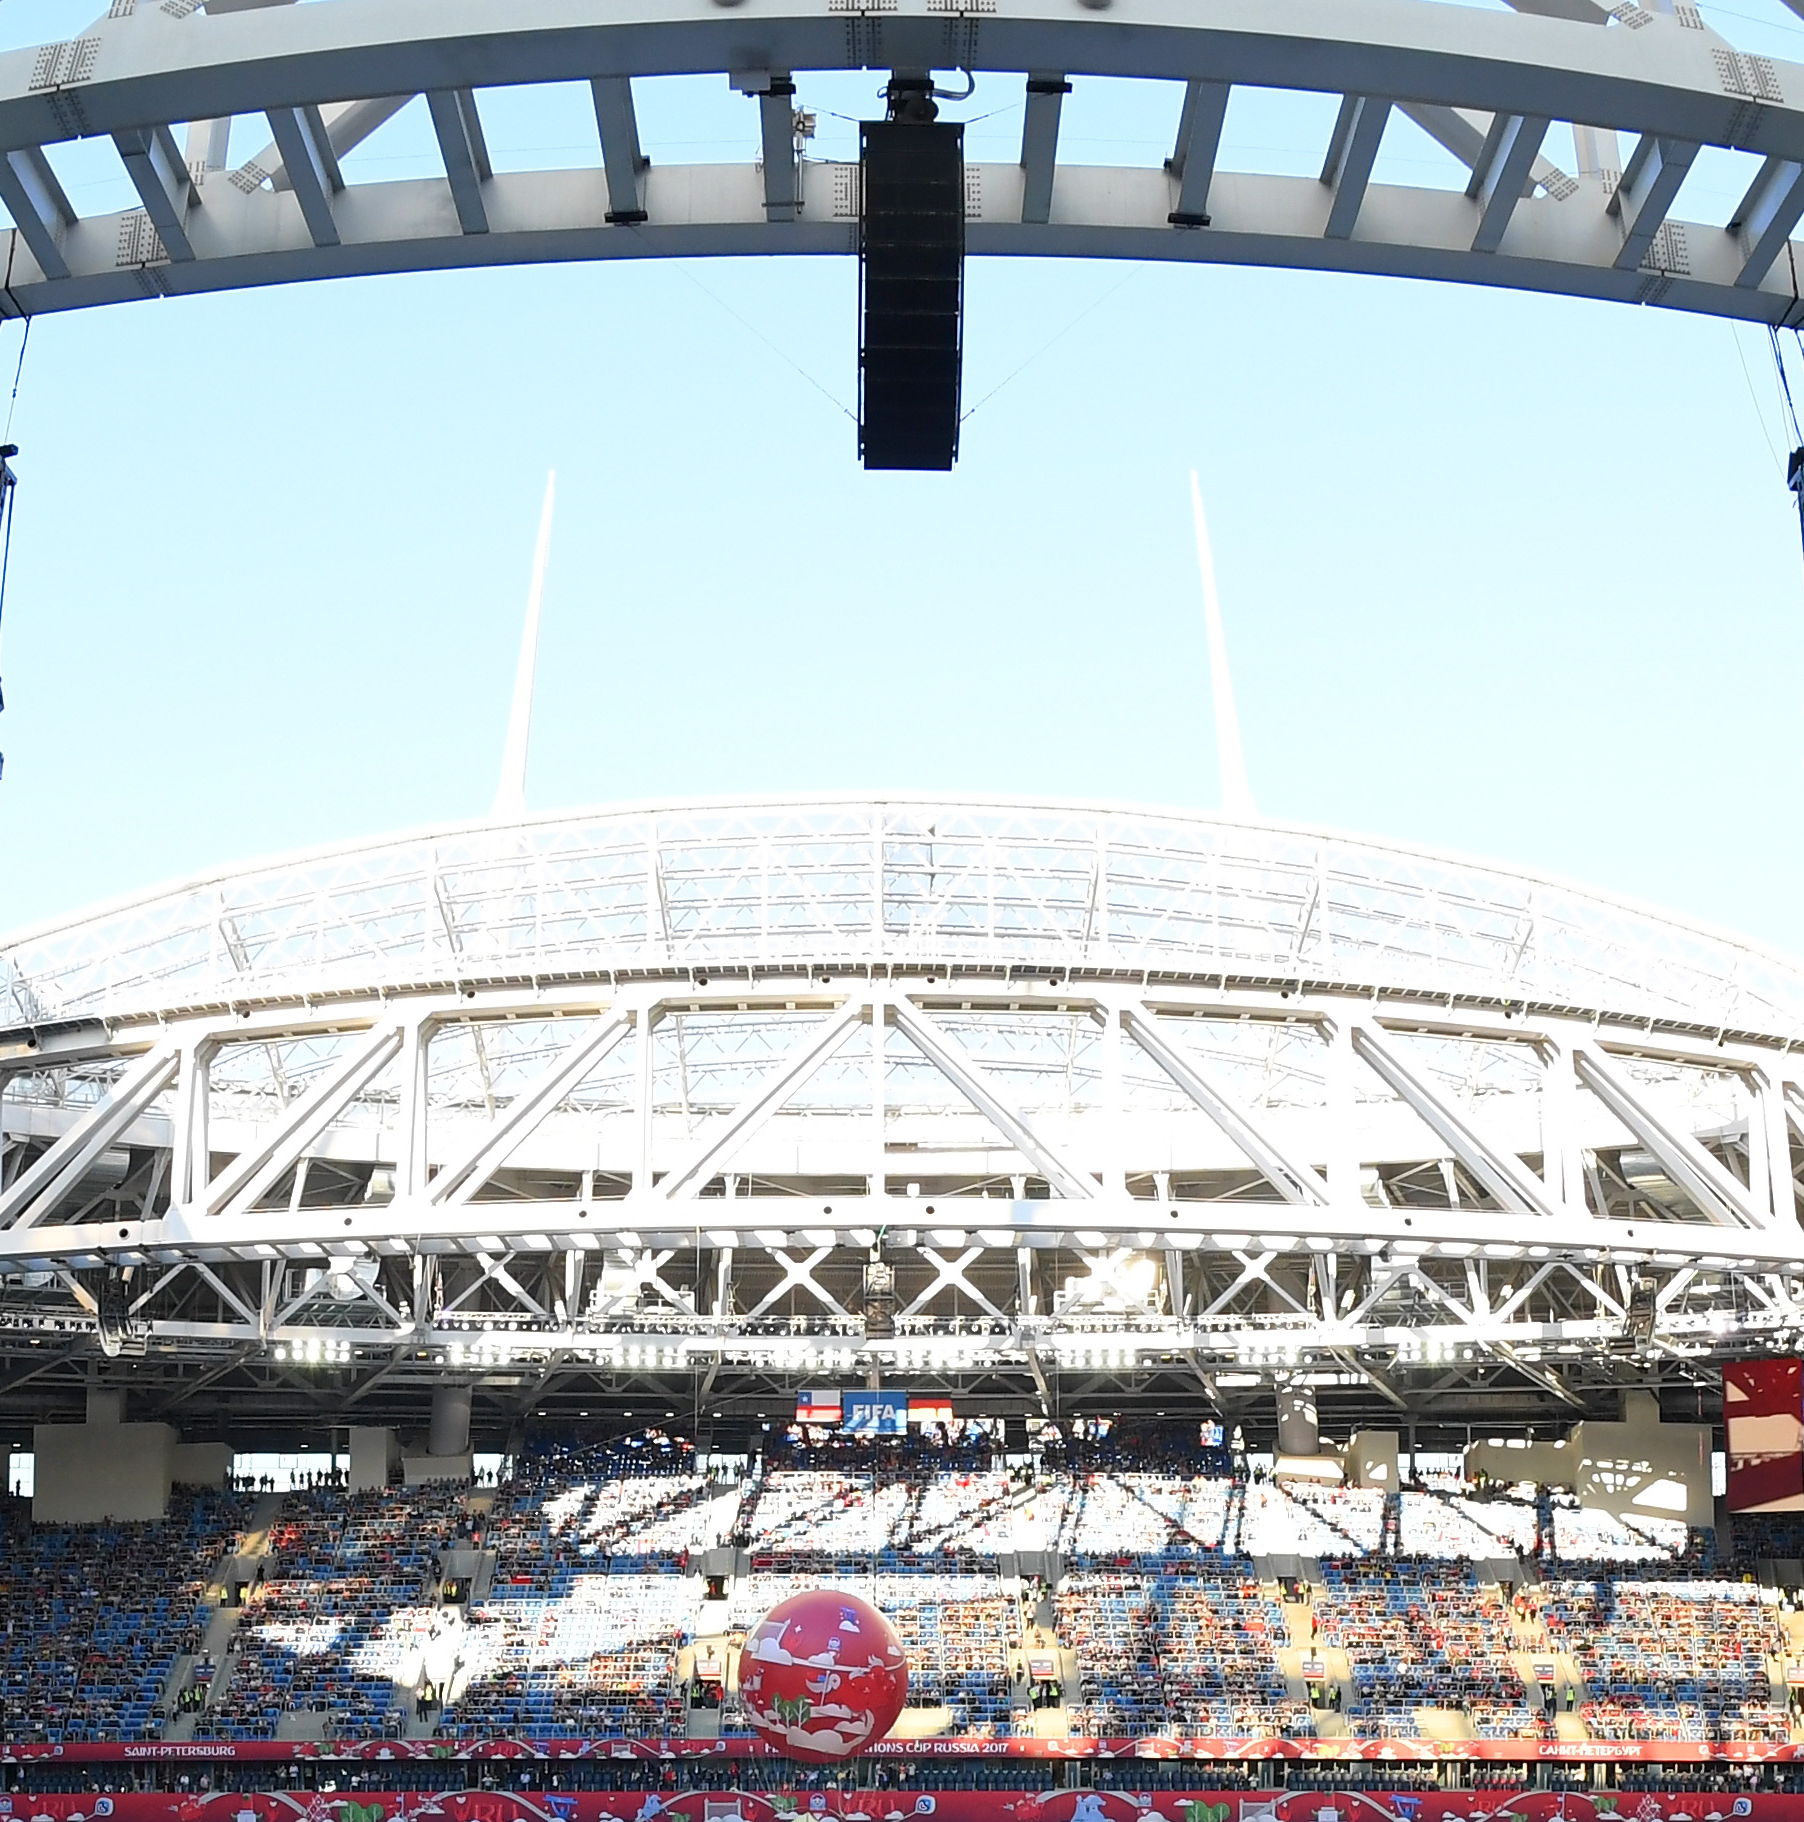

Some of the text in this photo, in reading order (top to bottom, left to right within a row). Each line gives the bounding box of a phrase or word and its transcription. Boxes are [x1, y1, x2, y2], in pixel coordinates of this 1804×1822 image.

[852, 1404, 895, 1420] FIFA
[124, 1746, 236, 1757] SAINT-PETERSBURG
[912, 1742, 931, 1754] CUP
[934, 1742, 979, 1754] RUSSIA
[982, 1742, 1009, 1754] 2017
